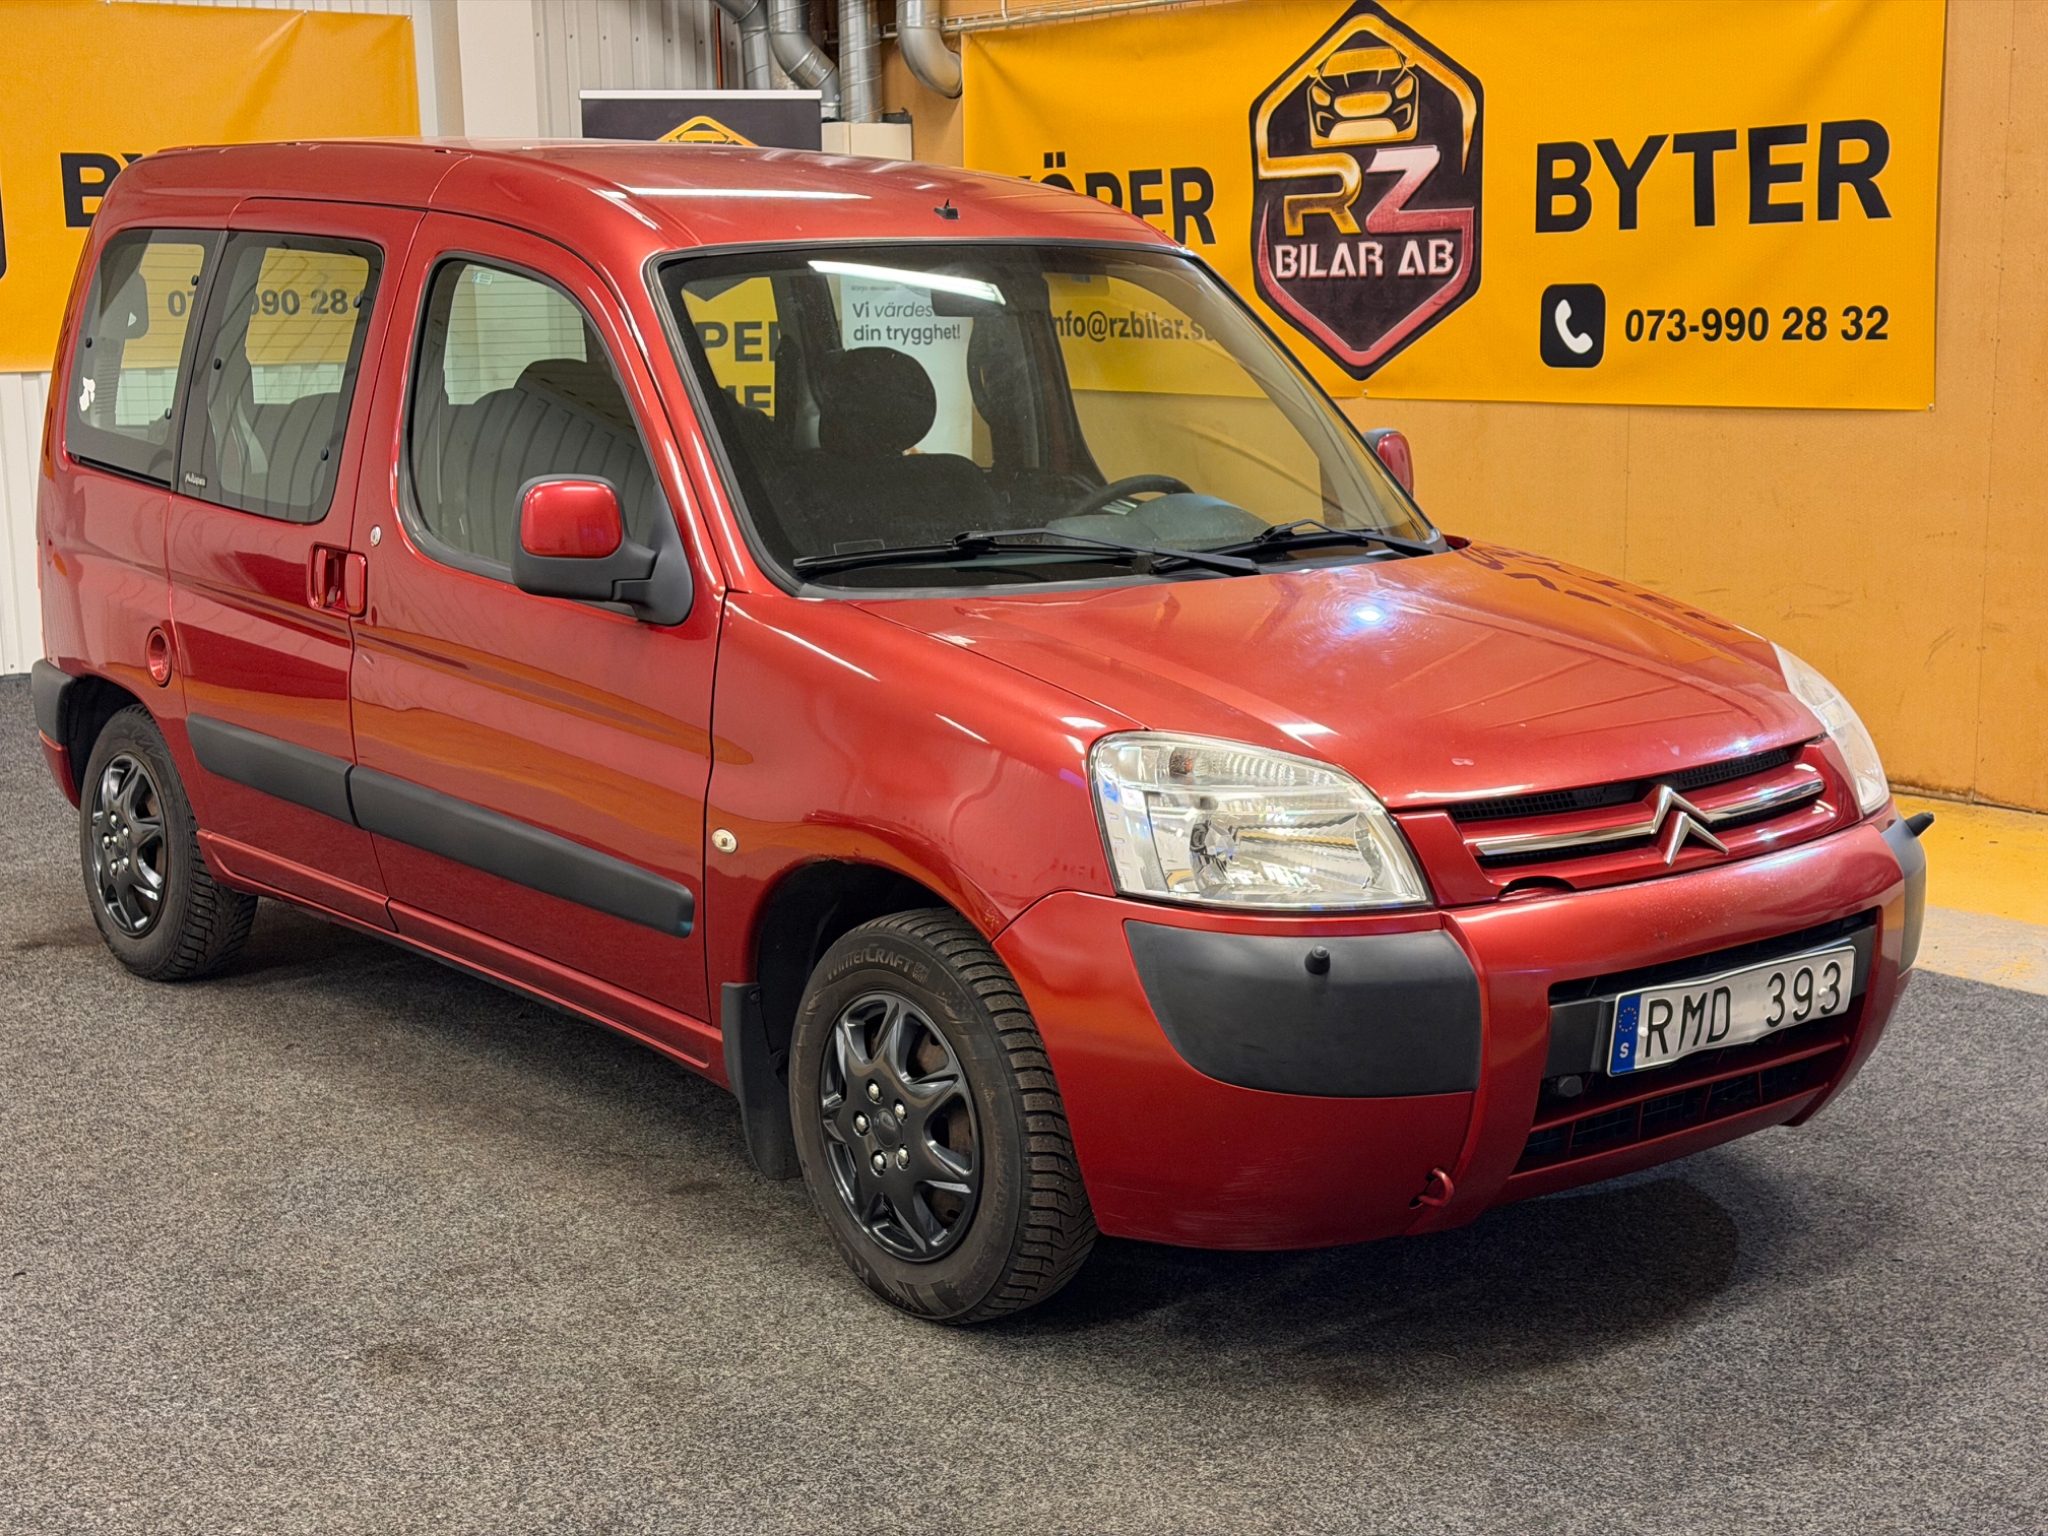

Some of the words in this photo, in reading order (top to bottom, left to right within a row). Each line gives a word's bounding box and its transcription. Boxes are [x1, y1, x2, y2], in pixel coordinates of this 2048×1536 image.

[60, 152, 143, 227] B
[1535, 119, 1892, 233] BYTER
[1274, 241, 1384, 279] BILAR
[1397, 238, 1455, 277] AB
[310, 288, 348, 315] 28
[852, 302, 870, 318] Vi
[853, 324, 882, 341] din
[886, 323, 961, 346] trygghet!
[1625, 307, 1770, 342] 073-990
[1782, 306, 1828, 341] 28
[1841, 305, 1890, 341] 32
[1644, 985, 1732, 1058] RMD
[1765, 960, 1842, 1028] 393
[1619, 1041, 1630, 1059] S
